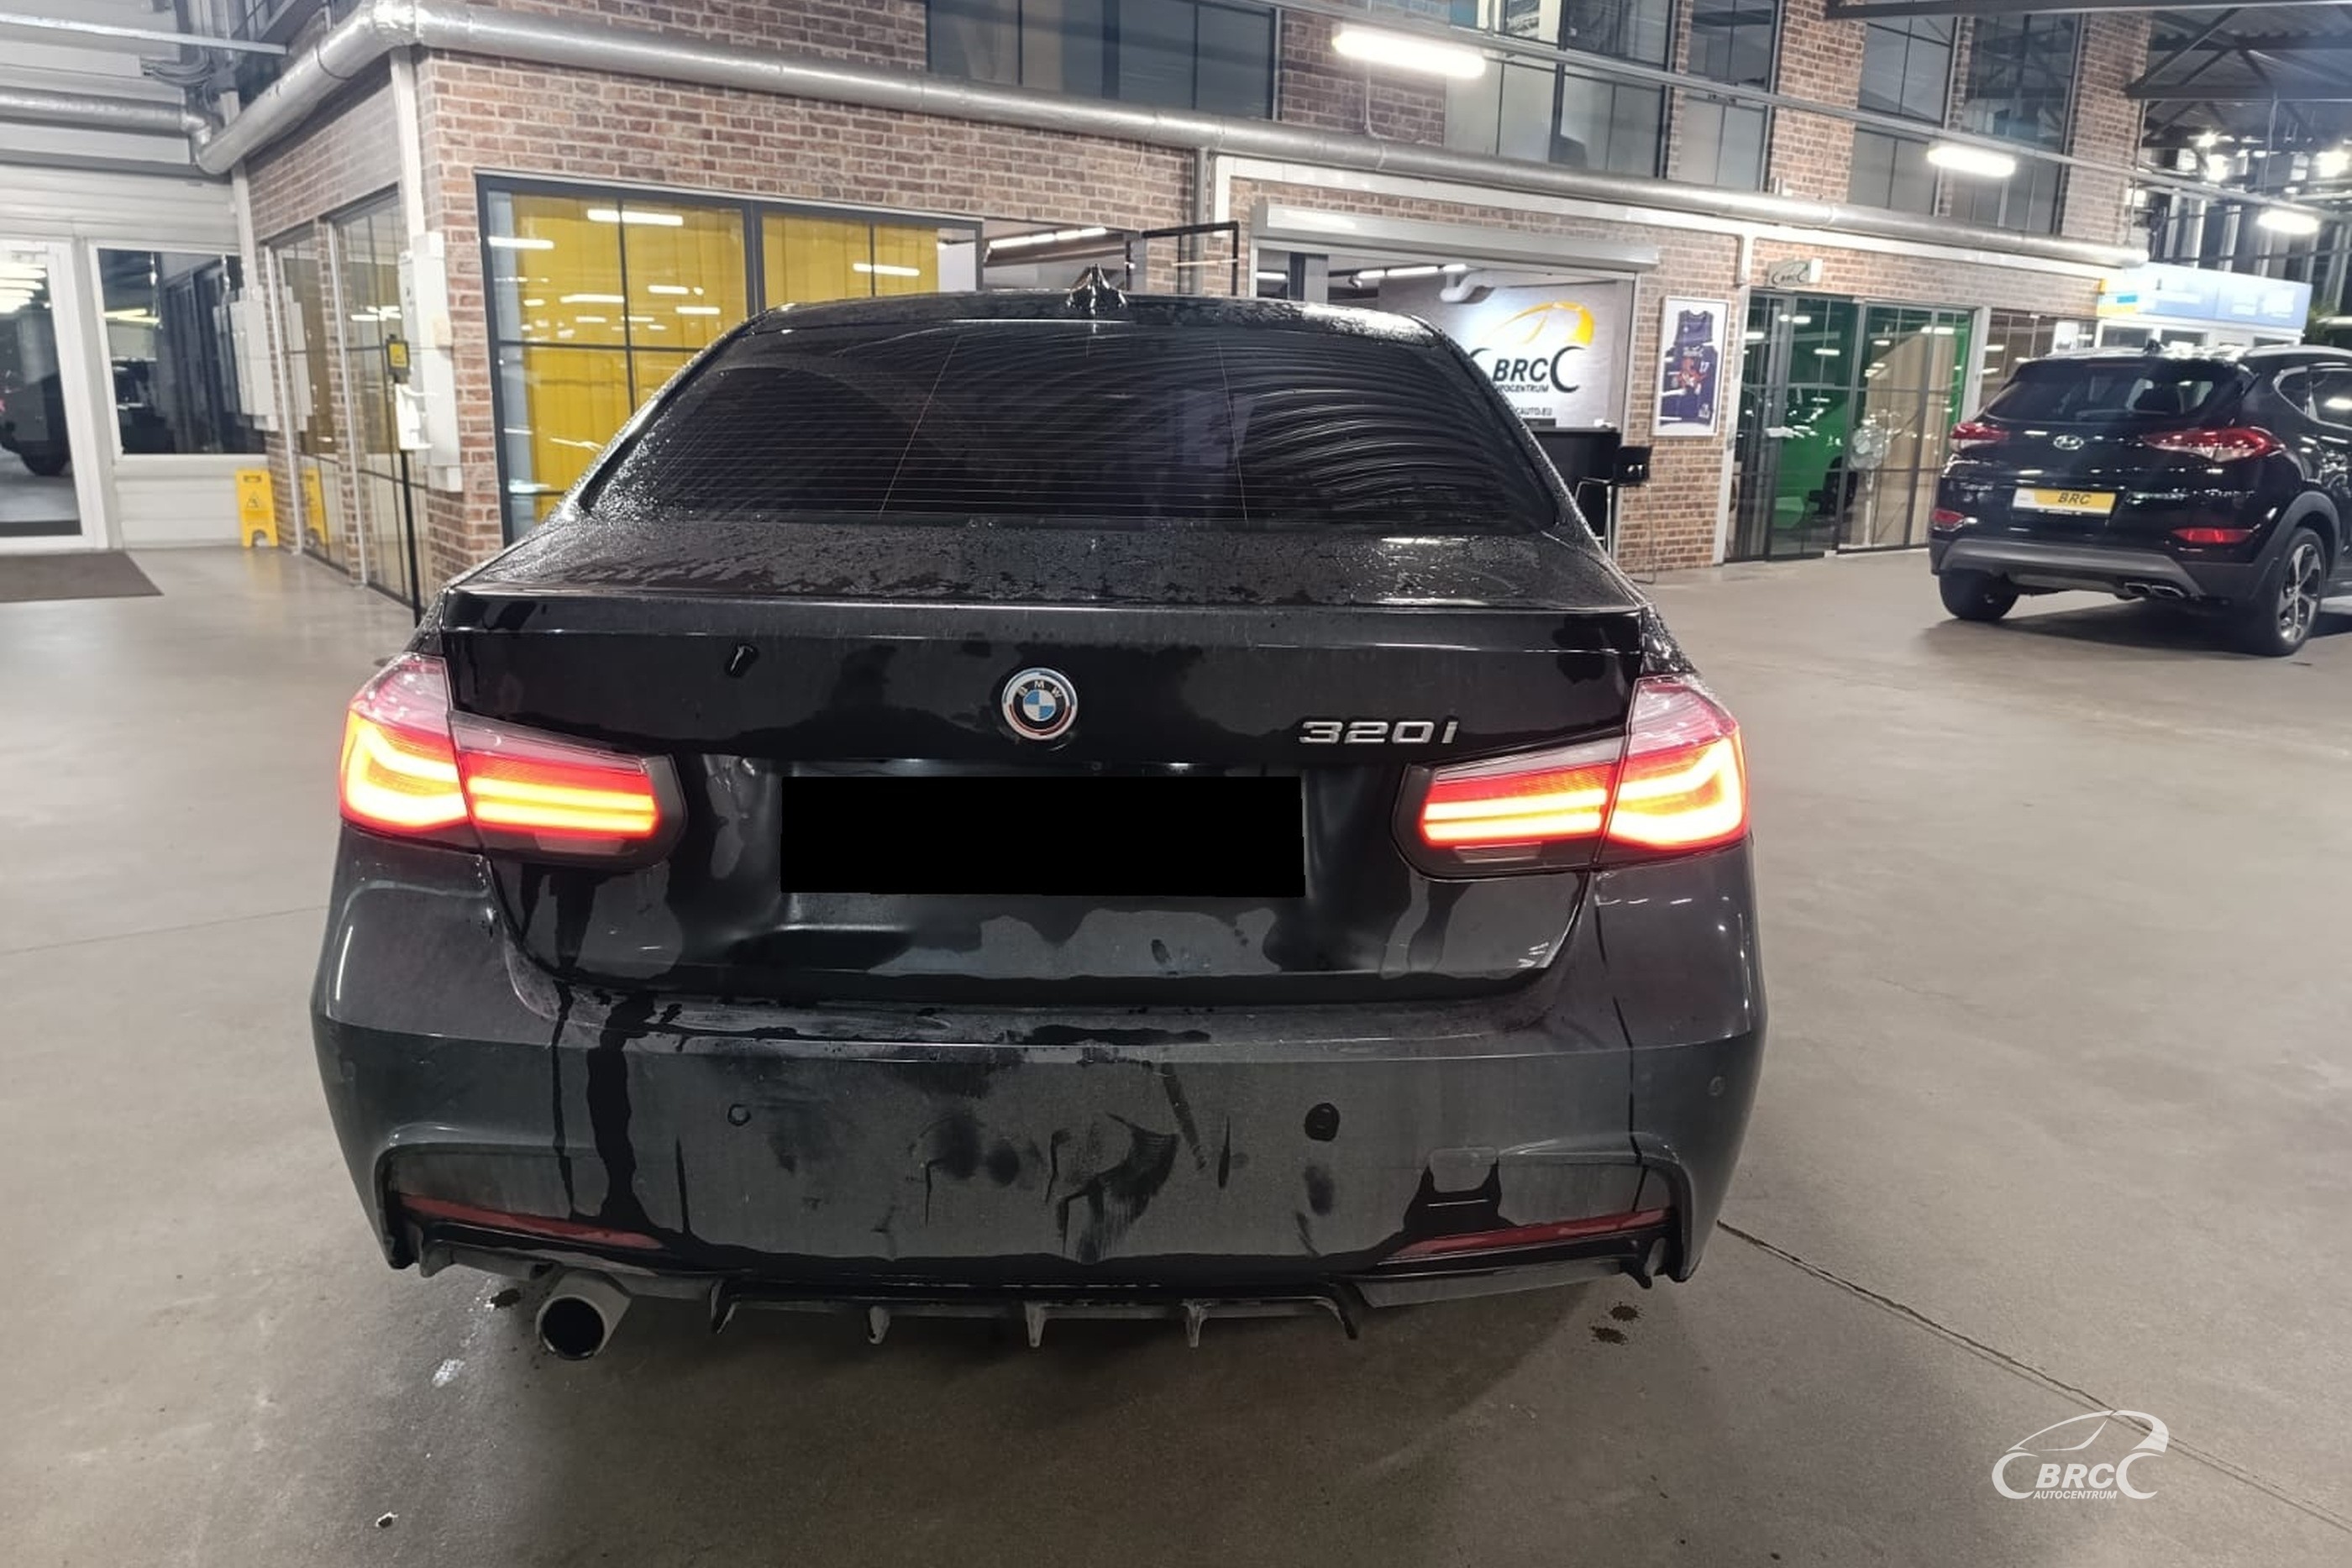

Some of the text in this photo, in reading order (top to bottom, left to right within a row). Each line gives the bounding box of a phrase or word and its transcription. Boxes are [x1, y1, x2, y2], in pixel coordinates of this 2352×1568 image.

[1492, 358, 1548, 382] BRC
[2058, 491, 2092, 505] BRC
[1017, 680, 1063, 699] BMW
[1299, 721, 1458, 744] 320i
